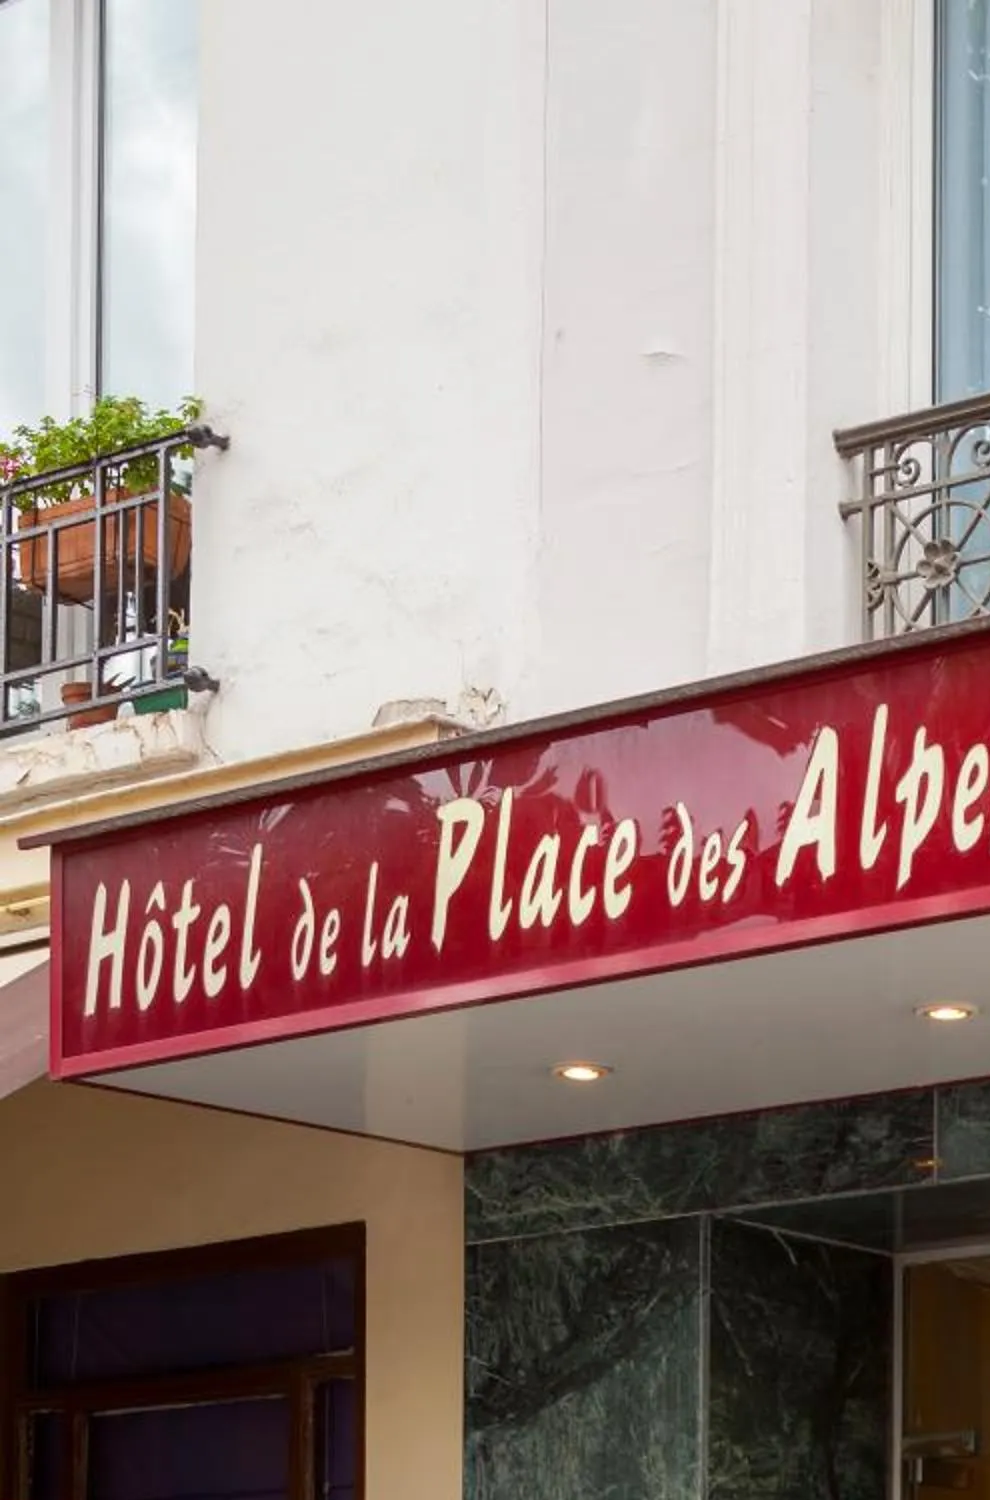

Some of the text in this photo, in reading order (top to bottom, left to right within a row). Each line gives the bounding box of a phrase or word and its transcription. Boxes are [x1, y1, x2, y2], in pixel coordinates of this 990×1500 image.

[84, 843, 265, 1017] Hôtel
[291, 878, 340, 981] de
[362, 861, 411, 967] la
[416, 765, 637, 951] Place
[667, 799, 749, 906] des
